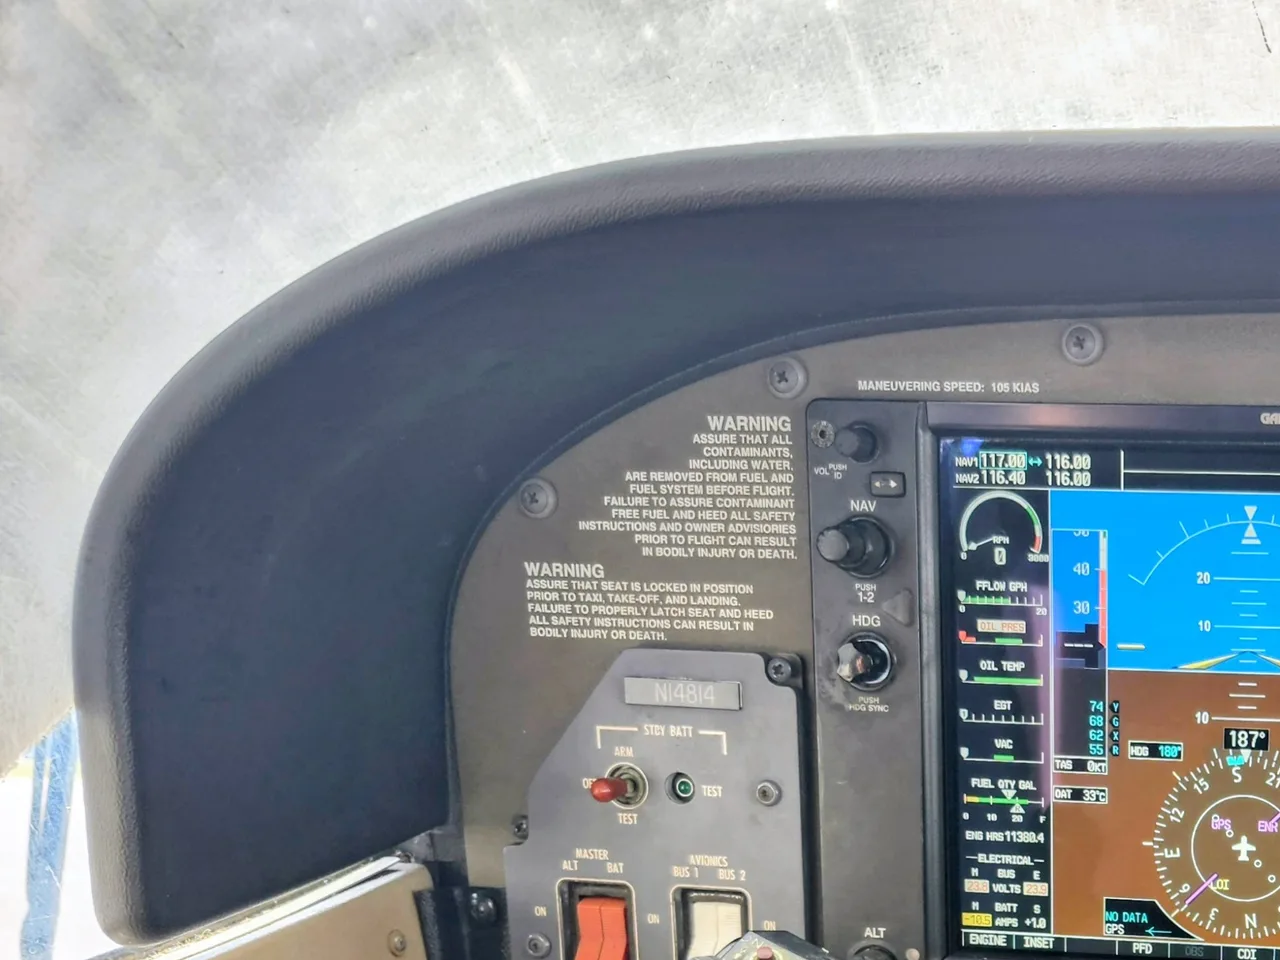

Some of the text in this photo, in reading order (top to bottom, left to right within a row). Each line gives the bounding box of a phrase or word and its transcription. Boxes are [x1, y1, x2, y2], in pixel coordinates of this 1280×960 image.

[858, 380, 1040, 394] MANEUVERING SPEED: 105 KIAS
[707, 416, 792, 432] WARNING
[693, 433, 792, 445] ASSURE THAT ALL
[703, 447, 793, 459] CONTAMINANTS,
[689, 459, 748, 470] INCLUDING
[955, 453, 1091, 470] NAV1 117.00 116.00
[955, 470, 1091, 486] NAV2 116.40 116.00
[630, 485, 795, 497] FUEL SYSTEM BEFORE FLIGHT.
[851, 500, 876, 512] NAV
[579, 521, 657, 533] INSTRUCTIONS
[660, 522, 682, 533] AND
[685, 523, 725, 533] OWNER
[635, 534, 797, 547] PRIOR TO FLIGHT CAN RESULT
[642, 547, 797, 560] IN BODILY INJURY OR DEATH.
[524, 562, 605, 578] WARNING
[1073, 563, 1090, 575] 40
[1196, 572, 1210, 585] 20
[526, 580, 754, 594] ASSURE THAT SEAT IS LOCKED IN POSITION
[855, 583, 876, 592] PUSH
[976, 581, 1027, 593] FFLOW GPH
[857, 592, 874, 603] 1-2
[528, 604, 773, 620] FAILURE TO PROPERLY LATCH SEAT AND HEED
[1073, 602, 1090, 614] 30
[852, 615, 881, 627] HDG
[1198, 620, 1211, 632] 10
[979, 622, 1025, 633] OIL PRES
[980, 660, 1025, 672] OIL TEMP
[994, 700, 1012, 711] EGT
[670, 726, 693, 738] BATT
[994, 738, 1013, 750] VAC
[1130, 746, 1149, 757] HDG
[971, 778, 1036, 791] FUEL QTY GAL
[966, 831, 983, 841] ENG
[986, 831, 1004, 842] HRS
[576, 849, 609, 861] MASTER
[689, 855, 728, 867] AVIONICS
[978, 854, 1034, 866] ELECTRICAL
[1105, 911, 1148, 923] NO DATA
[1105, 924, 1125, 935] GPS
[969, 935, 1007, 947] ENGINE
[1023, 937, 1054, 949] INSET
[1133, 943, 1152, 955] PFD
[1237, 948, 1256, 960] CDI
